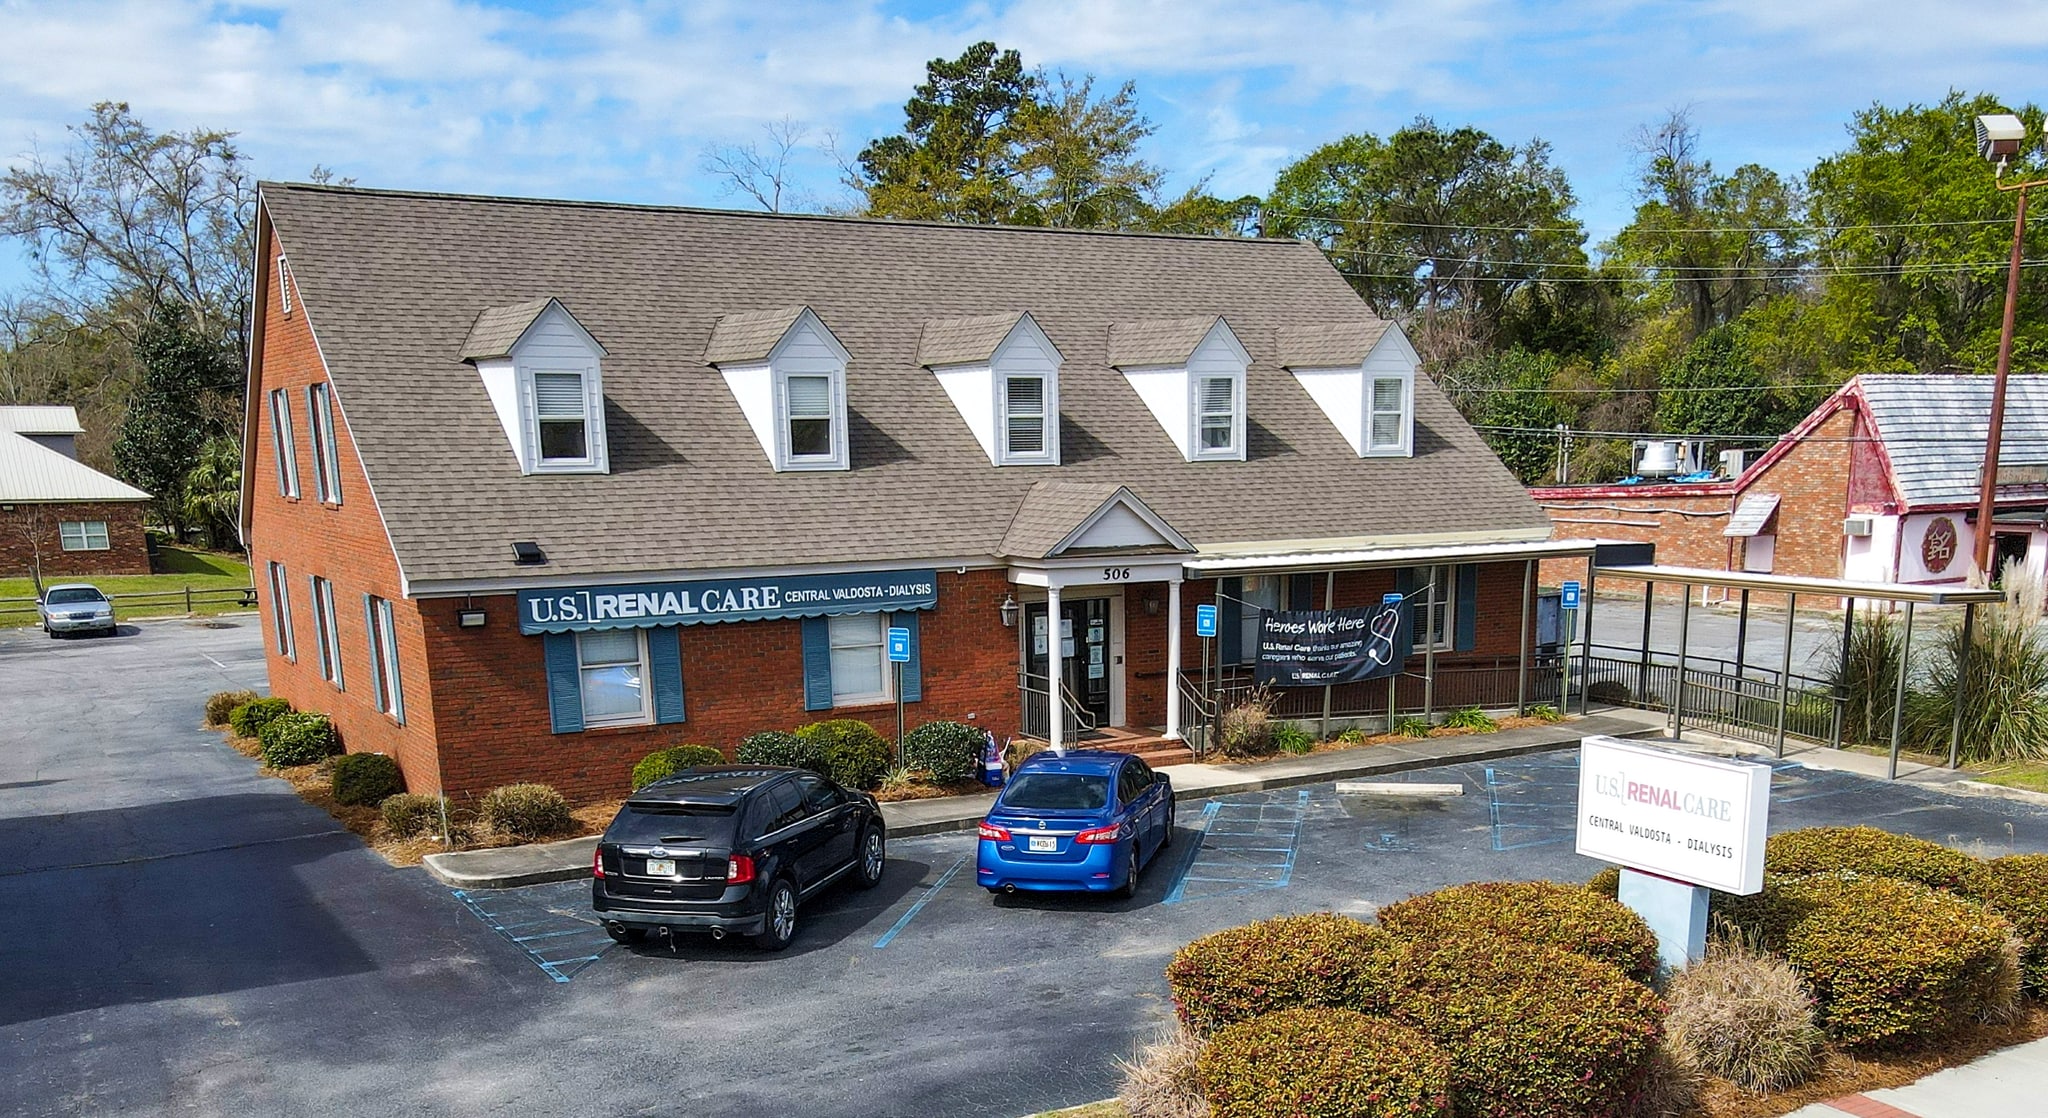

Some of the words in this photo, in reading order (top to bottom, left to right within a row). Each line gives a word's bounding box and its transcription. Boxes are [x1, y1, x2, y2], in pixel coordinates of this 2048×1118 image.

[1103, 568, 1130, 581] 506
[595, 590, 698, 619] RENAL
[701, 586, 781, 613] CARE
[785, 590, 831, 603] CENTRAL
[1265, 617, 1305, 634] Heroes
[1308, 618, 1335, 634] Work
[1337, 616, 1365, 630] Here
[1275, 643, 1293, 651] Renal
[1294, 644, 1311, 652] Care
[1301, 672, 1321, 680] RENAL
[1627, 781, 1682, 811] RENAL
[1683, 792, 1732, 822] CARE
[1589, 815, 1624, 833] CENTRAL
[1629, 824, 1672, 844] VALDOSTA
[1687, 838, 1733, 859] DIALYSIS
